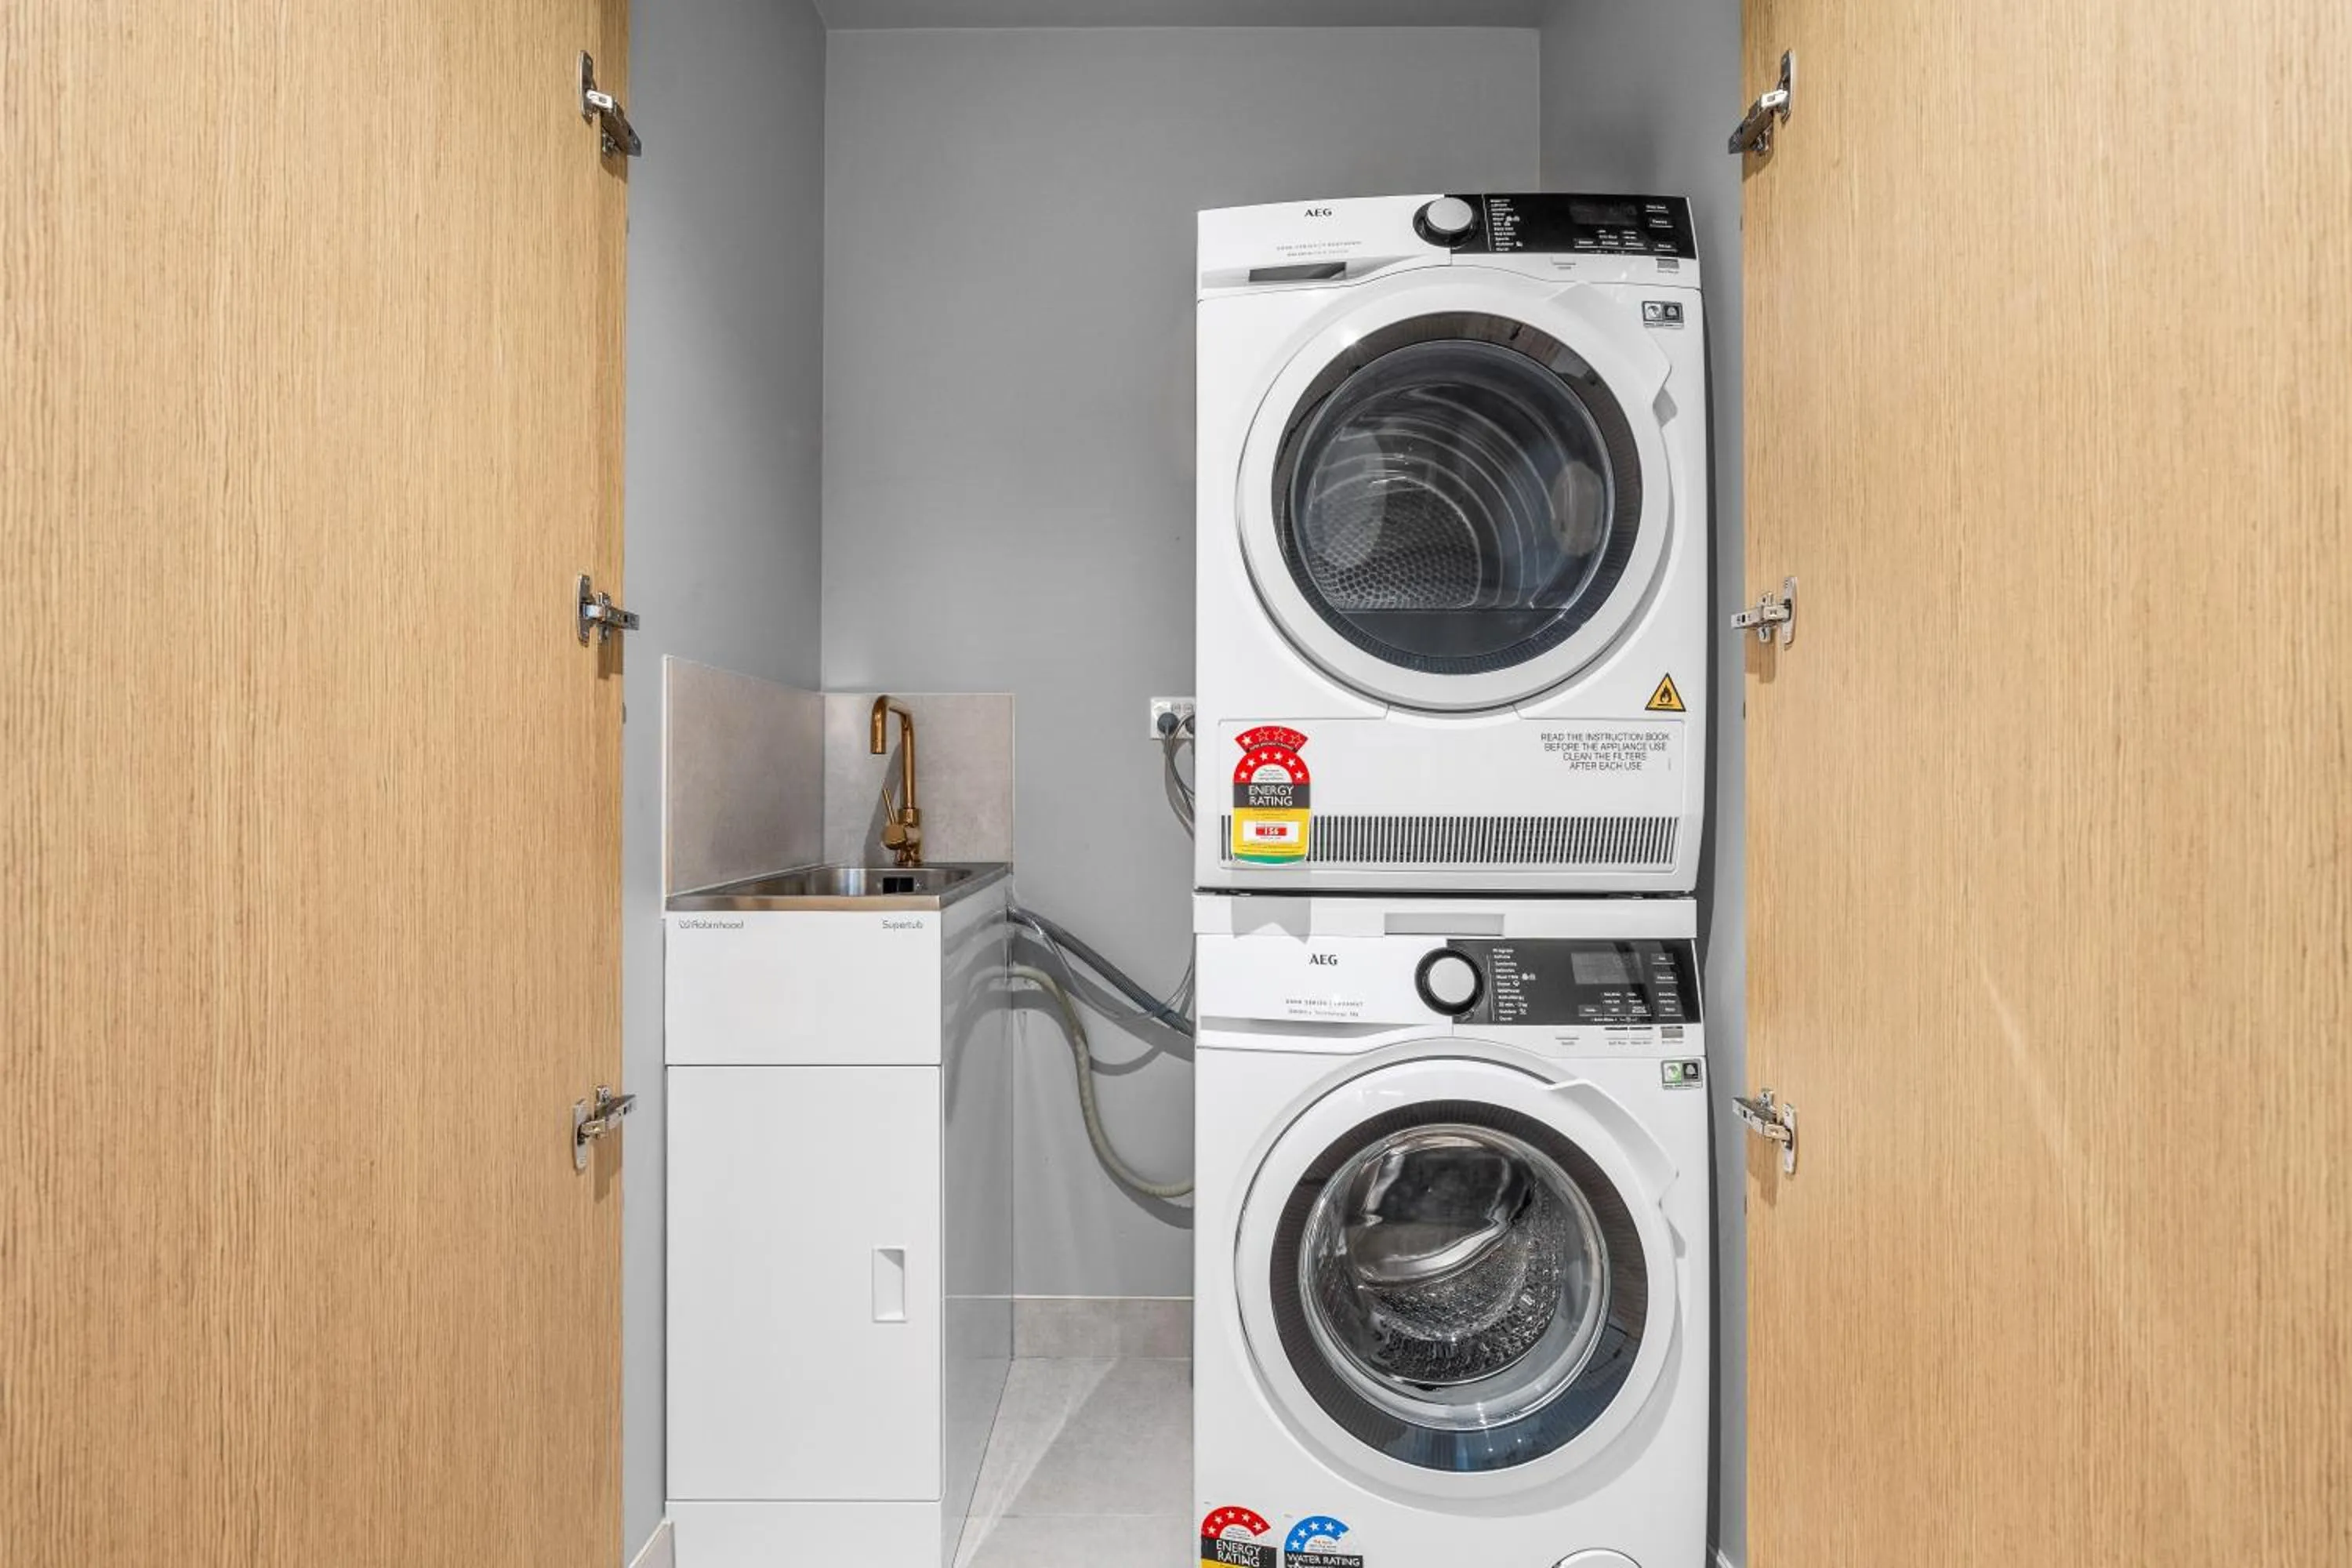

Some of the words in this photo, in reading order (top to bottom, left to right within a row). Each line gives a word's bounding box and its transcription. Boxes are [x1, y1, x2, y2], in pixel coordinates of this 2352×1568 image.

[1305, 209, 1332, 217] AEG
[1646, 732, 1670, 741] BOOK
[1601, 742, 1646, 751] APPLIANCE
[1650, 742, 1667, 751] USE
[1249, 785, 1294, 796] ENERGY
[1249, 797, 1293, 807] RATING
[691, 918, 744, 929] Robinhood
[1309, 953, 1338, 965] AEG
[1216, 1539, 1261, 1556] ENERGY
[1217, 1551, 1260, 1567] RATING
[1287, 1554, 1321, 1564] WATER
[1323, 1555, 1360, 1566] RATING
